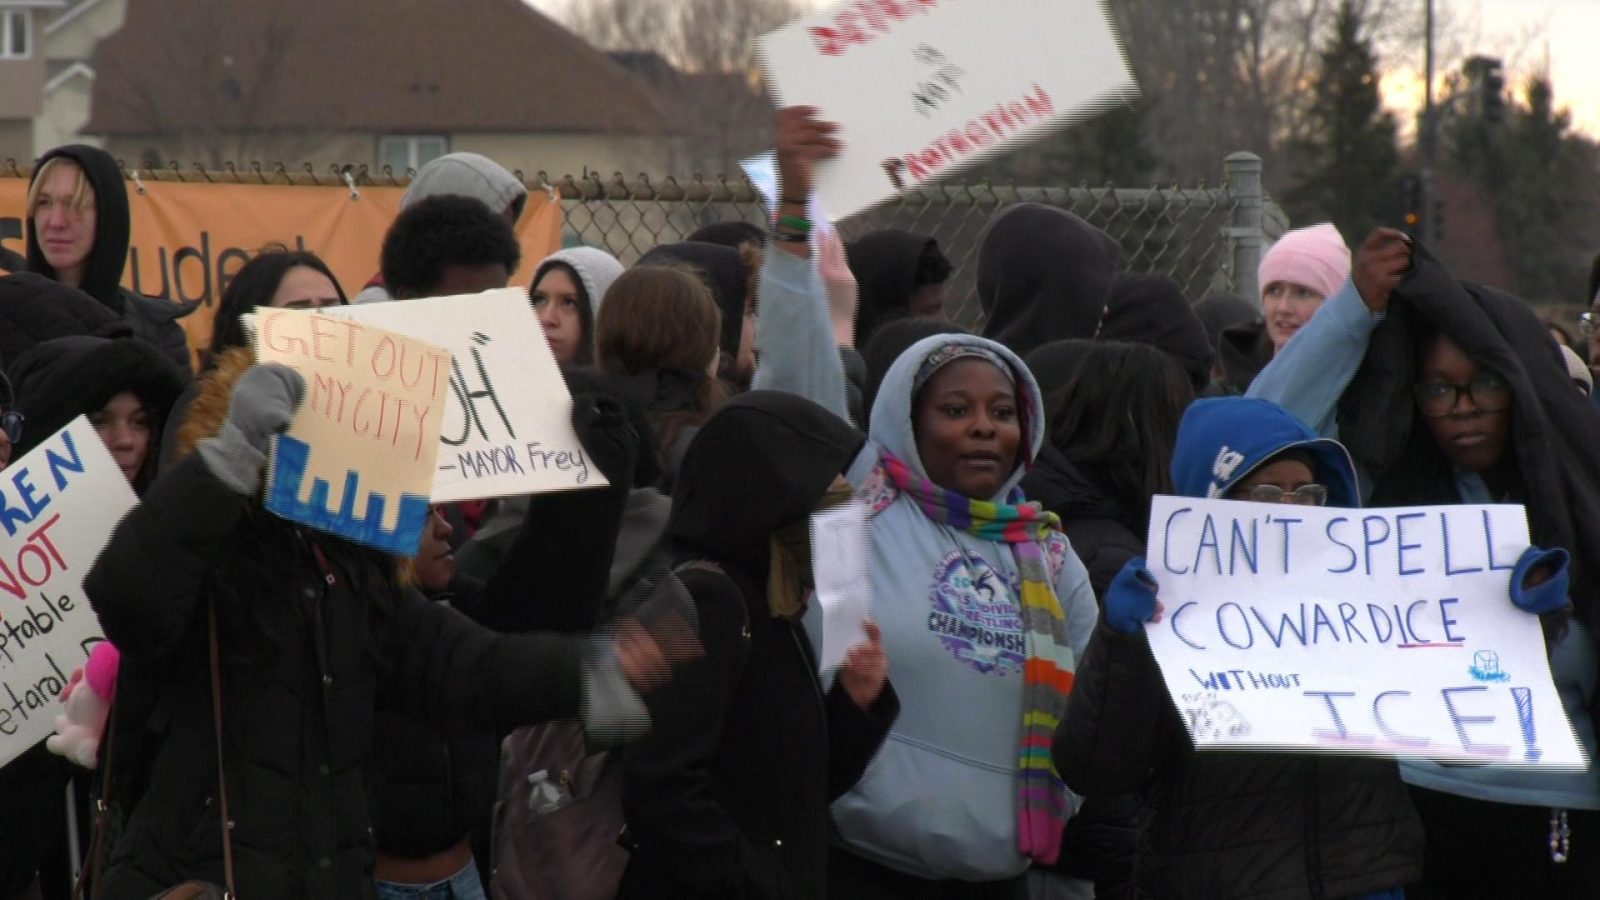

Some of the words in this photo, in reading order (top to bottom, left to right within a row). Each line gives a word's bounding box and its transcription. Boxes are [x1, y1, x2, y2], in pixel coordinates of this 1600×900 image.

[879, 80, 1055, 191] PROTECTION
[264, 312, 361, 369] GET
[371, 336, 450, 402] OUT
[311, 372, 354, 424] MY
[352, 388, 430, 462] CITY
[525, 441, 588, 485] Frey
[1163, 507, 1303, 576] CAN'T
[1325, 509, 1516, 576] SPELL
[1170, 598, 1466, 650] COWARDICE
[1188, 668, 1300, 691] WITHOUT
